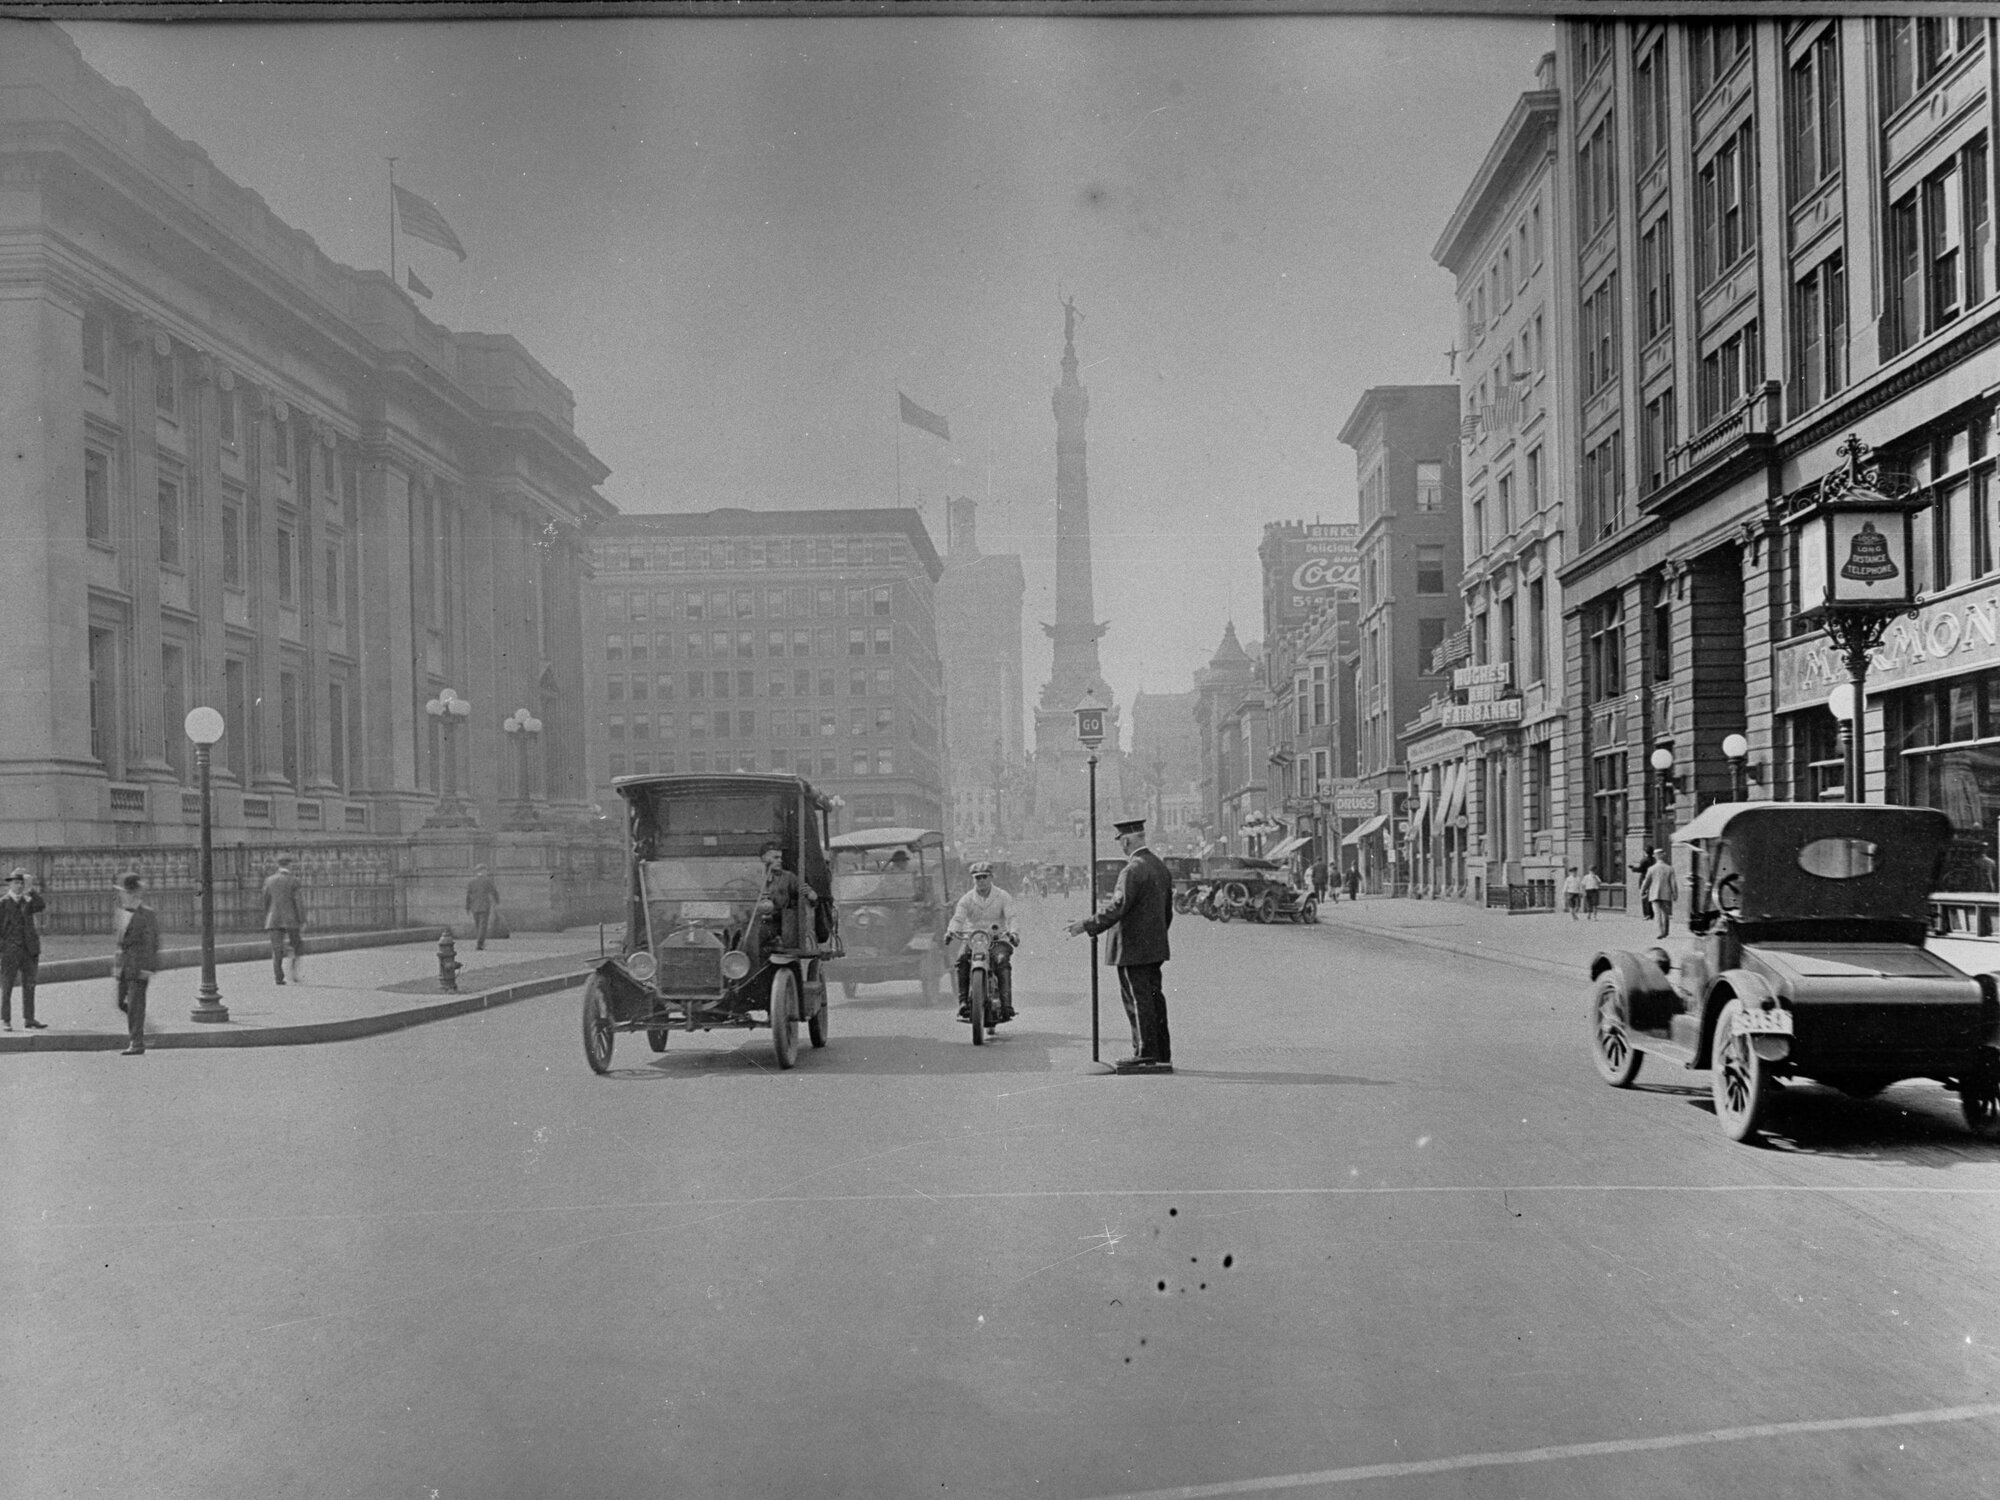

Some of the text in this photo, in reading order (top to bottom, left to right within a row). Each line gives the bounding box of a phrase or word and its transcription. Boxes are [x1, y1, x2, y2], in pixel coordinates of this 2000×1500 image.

[1857, 545, 1882, 553] LONG
[1852, 554, 1886, 563] DISTANCE
[1847, 564, 1893, 575] TELEPHONE
[1444, 701, 1517, 724] FAIRBANKS
[1082, 719, 1099, 730] GO
[1337, 797, 1375, 809] DRUGS
